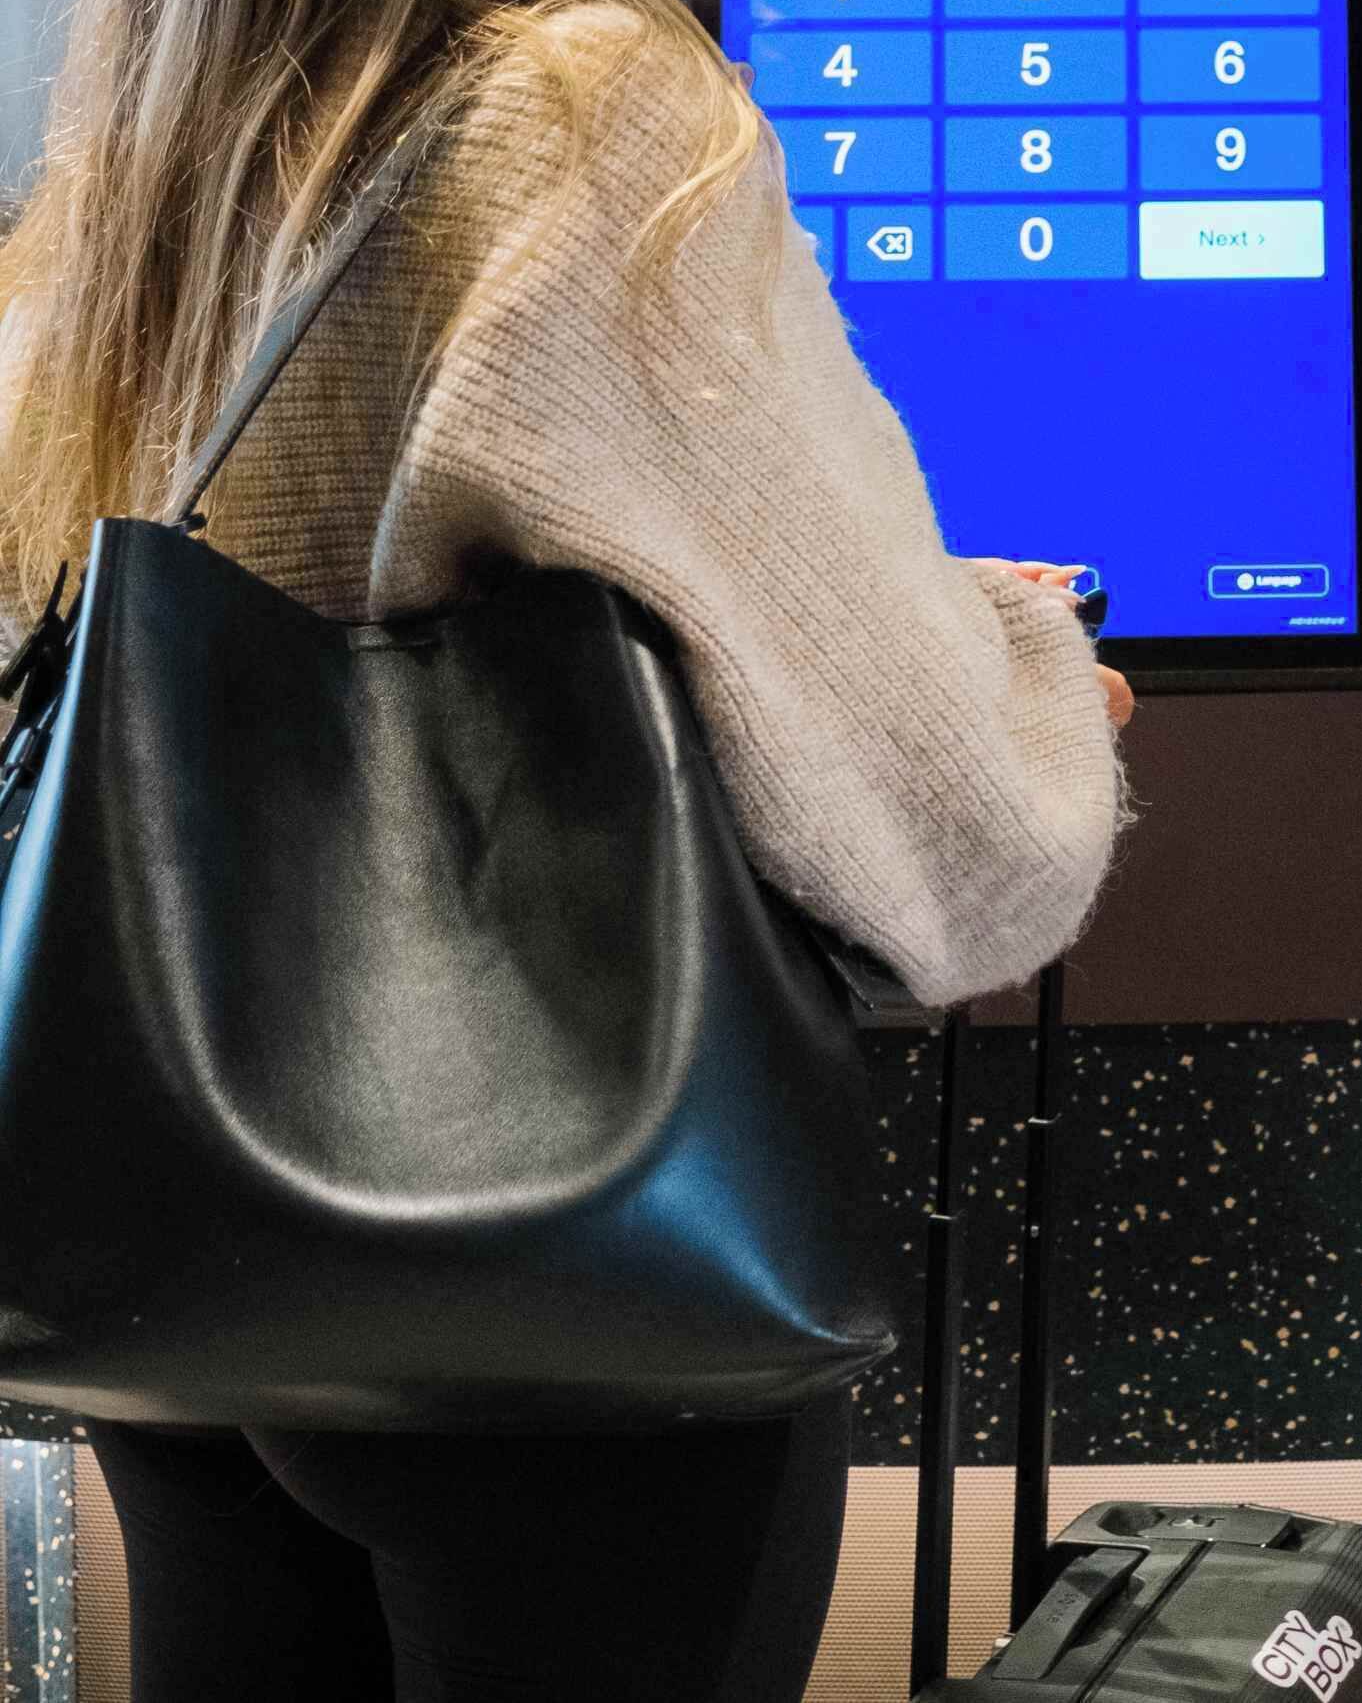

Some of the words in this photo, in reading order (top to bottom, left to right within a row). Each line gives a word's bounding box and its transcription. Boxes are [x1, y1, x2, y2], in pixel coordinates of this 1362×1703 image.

[824, 45, 857, 87] 4
[1021, 43, 1051, 85] 5
[1215, 41, 1245, 84] 6
[825, 132, 856, 174] 7
[1021, 130, 1052, 173] 8
[1216, 128, 1245, 170] 9
[1020, 217, 1052, 261] 0
[1199, 230, 1248, 246] Next
[1262, 1616, 1317, 1680] CITY
[1304, 1626, 1357, 1694] BOX
